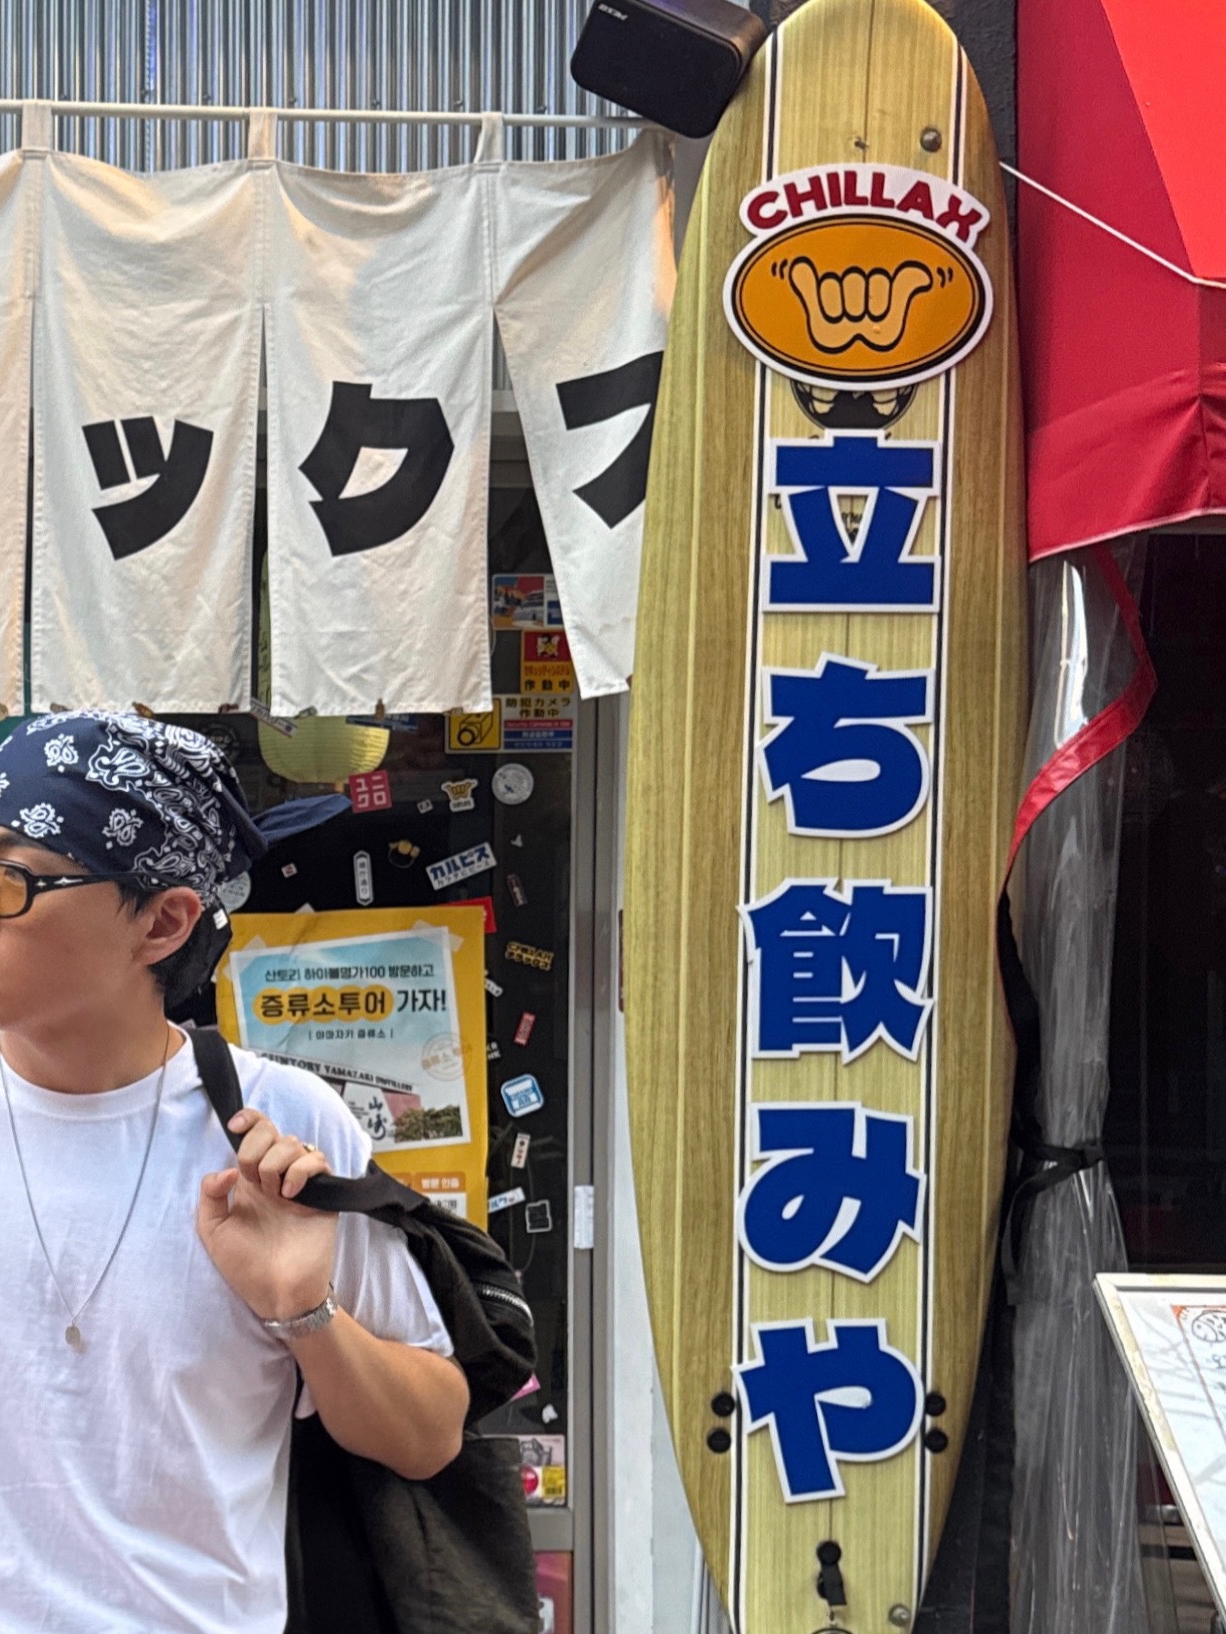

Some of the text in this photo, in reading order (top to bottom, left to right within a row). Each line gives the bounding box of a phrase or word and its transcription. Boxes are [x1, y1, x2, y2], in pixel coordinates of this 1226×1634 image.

[747, 170, 982, 243] CHILLAX
[430, 846, 489, 880] カルピス
[265, 969, 300, 982] 산토리
[388, 964, 434, 978] 방문하고
[736, 430, 939, 1500] 立ち飲みや
[260, 989, 446, 1018] 증류소투어 가자!
